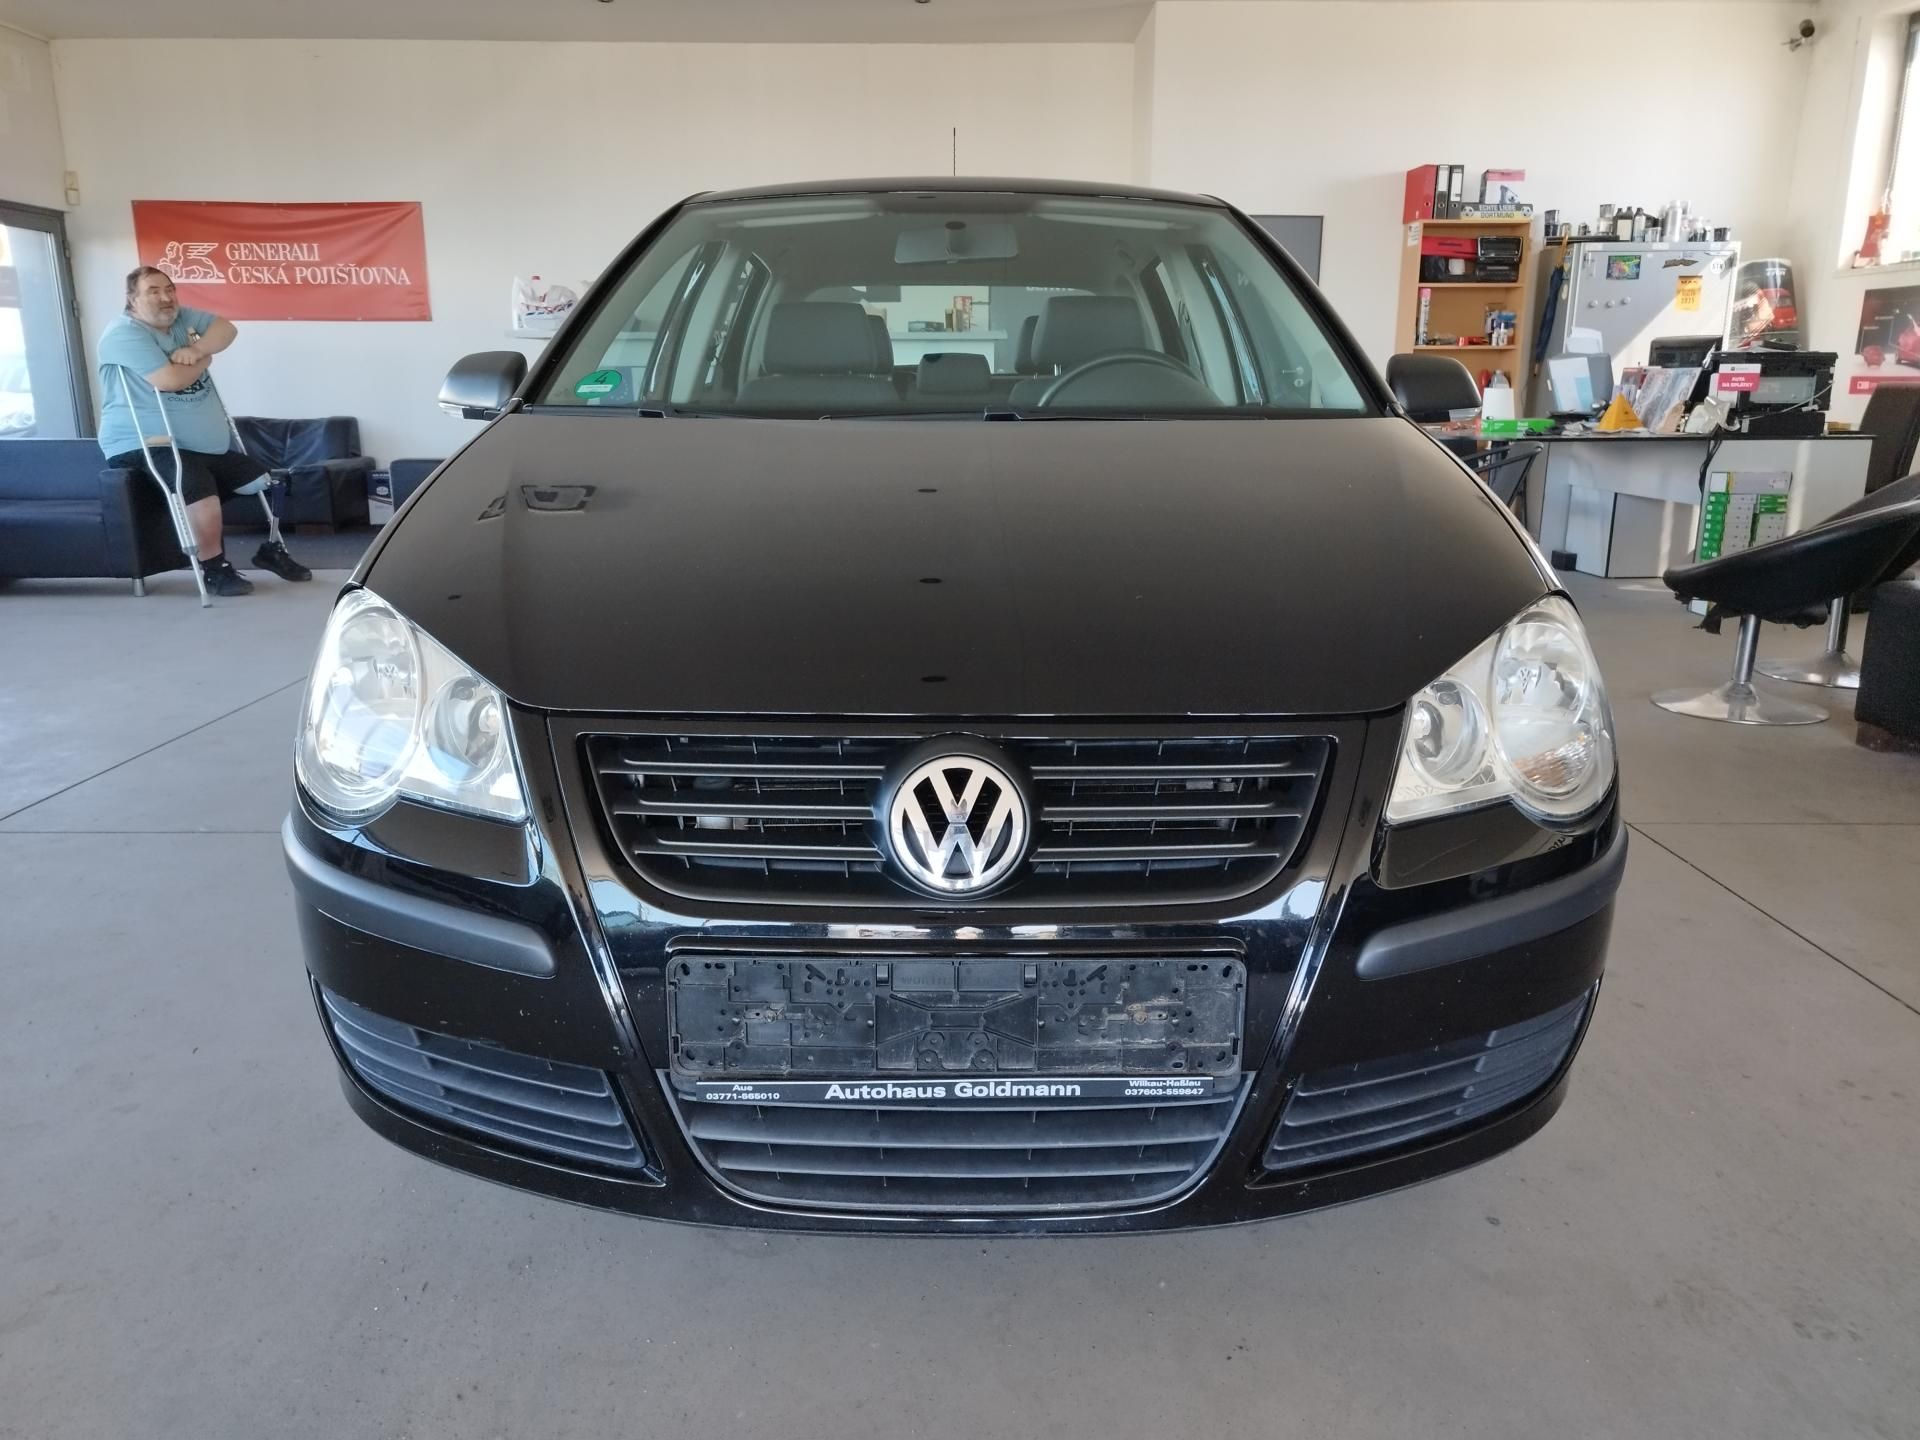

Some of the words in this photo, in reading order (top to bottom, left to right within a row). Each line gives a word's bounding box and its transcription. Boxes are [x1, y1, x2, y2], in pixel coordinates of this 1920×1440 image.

[225, 242, 320, 262] GENERALI
[227, 262, 289, 285] ČESKÁ
[294, 263, 412, 285] POJIŠŤOVNA
[594, 371, 608, 384] 4
[891, 756, 1025, 891] VW
[825, 1083, 946, 1100] Autohaus
[954, 1081, 1081, 1098] Goldmann
